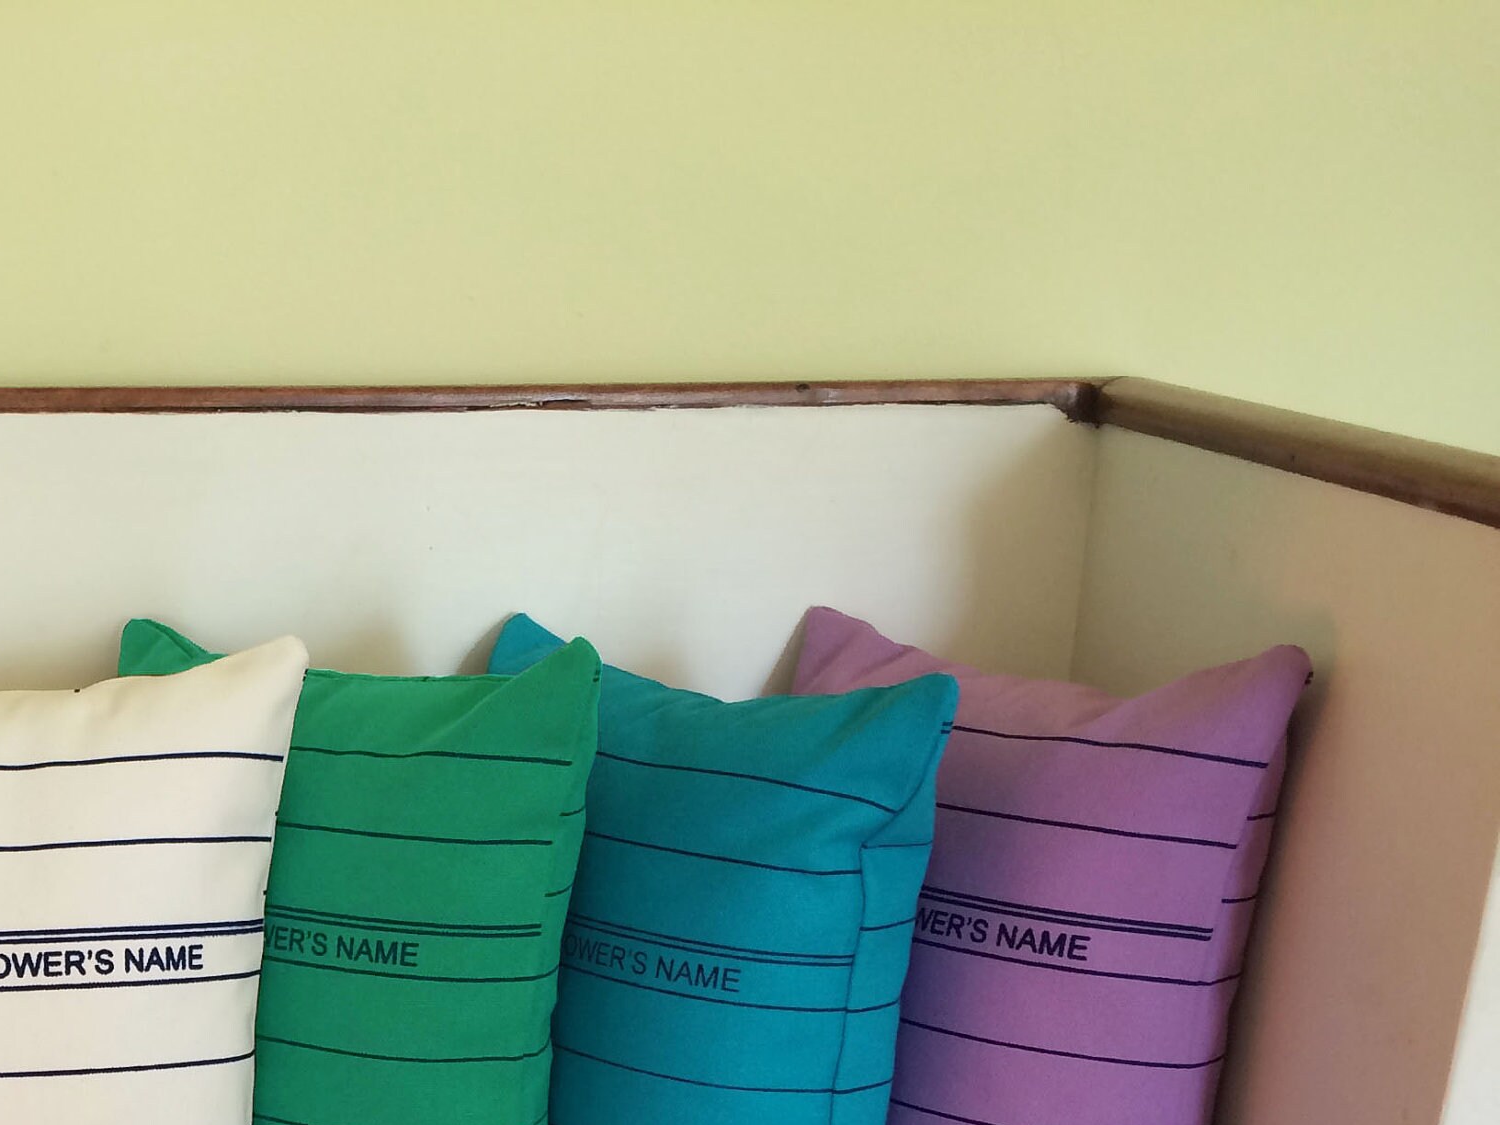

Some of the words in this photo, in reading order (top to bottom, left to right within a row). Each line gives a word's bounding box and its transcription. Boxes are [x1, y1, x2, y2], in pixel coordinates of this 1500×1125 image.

[124, 944, 204, 972] NAME
[336, 935, 419, 967] NAME
[996, 923, 1091, 961] NAME
[655, 956, 741, 993] NAME
